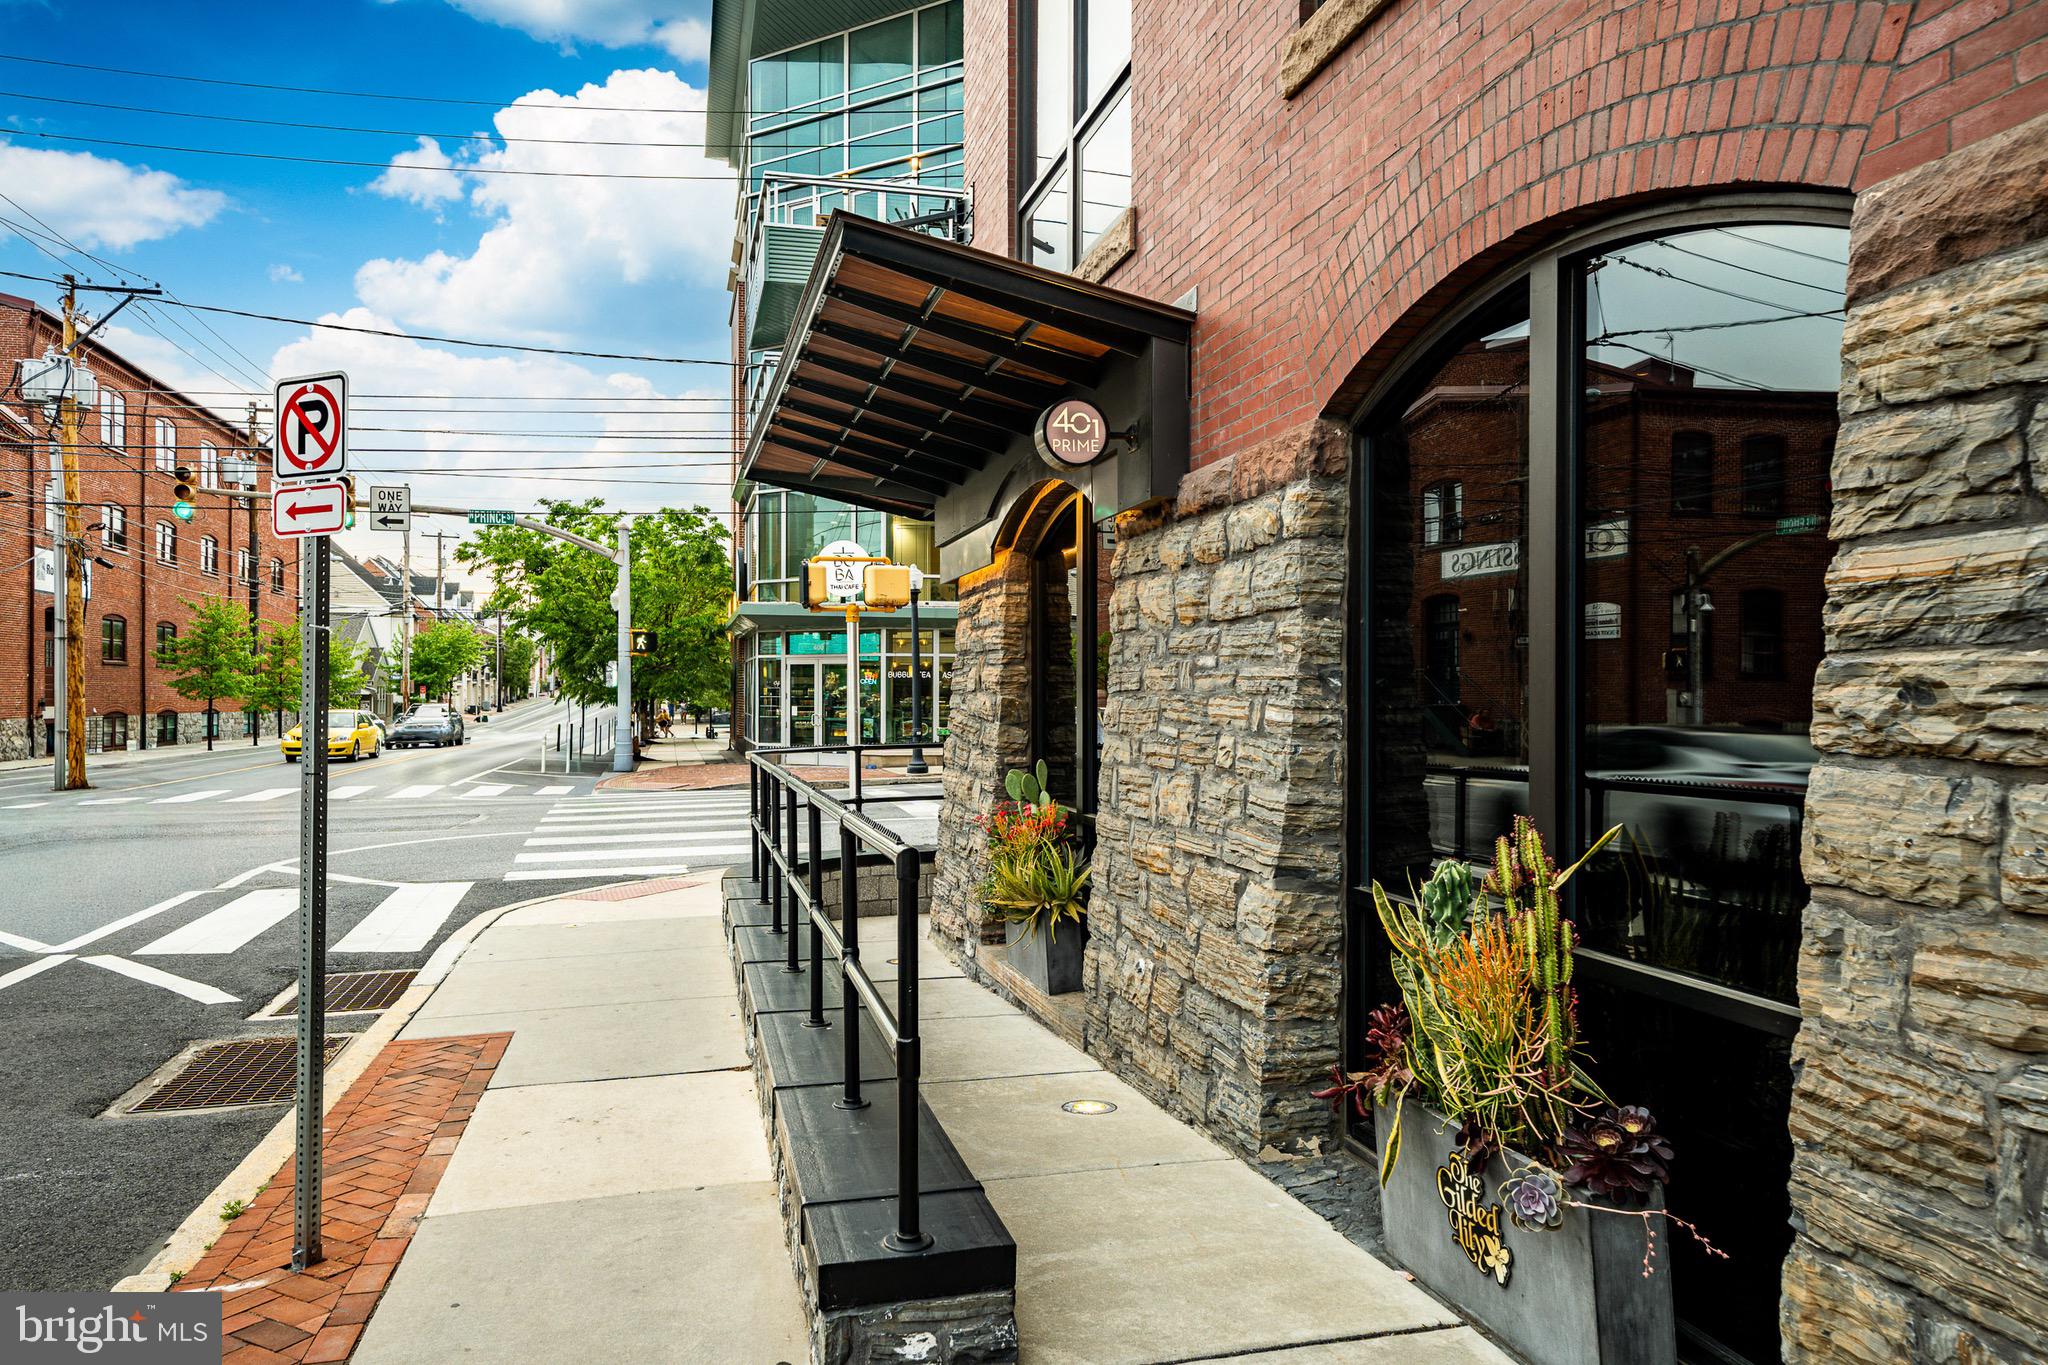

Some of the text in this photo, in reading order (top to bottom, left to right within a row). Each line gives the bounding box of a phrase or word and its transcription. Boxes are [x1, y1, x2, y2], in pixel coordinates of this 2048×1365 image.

[1052, 406, 1099, 439] 401
[1052, 438, 1100, 453] PRIME
[378, 490, 403, 501] ONE
[378, 503, 403, 512] WAY
[474, 510, 506, 524] PRINCE
[506, 511, 514, 521] ST
[835, 569, 854, 581] BA
[1449, 1152, 1481, 1194] The
[1437, 1167, 1500, 1236] Gilded
[1449, 1208, 1487, 1273] Lily
